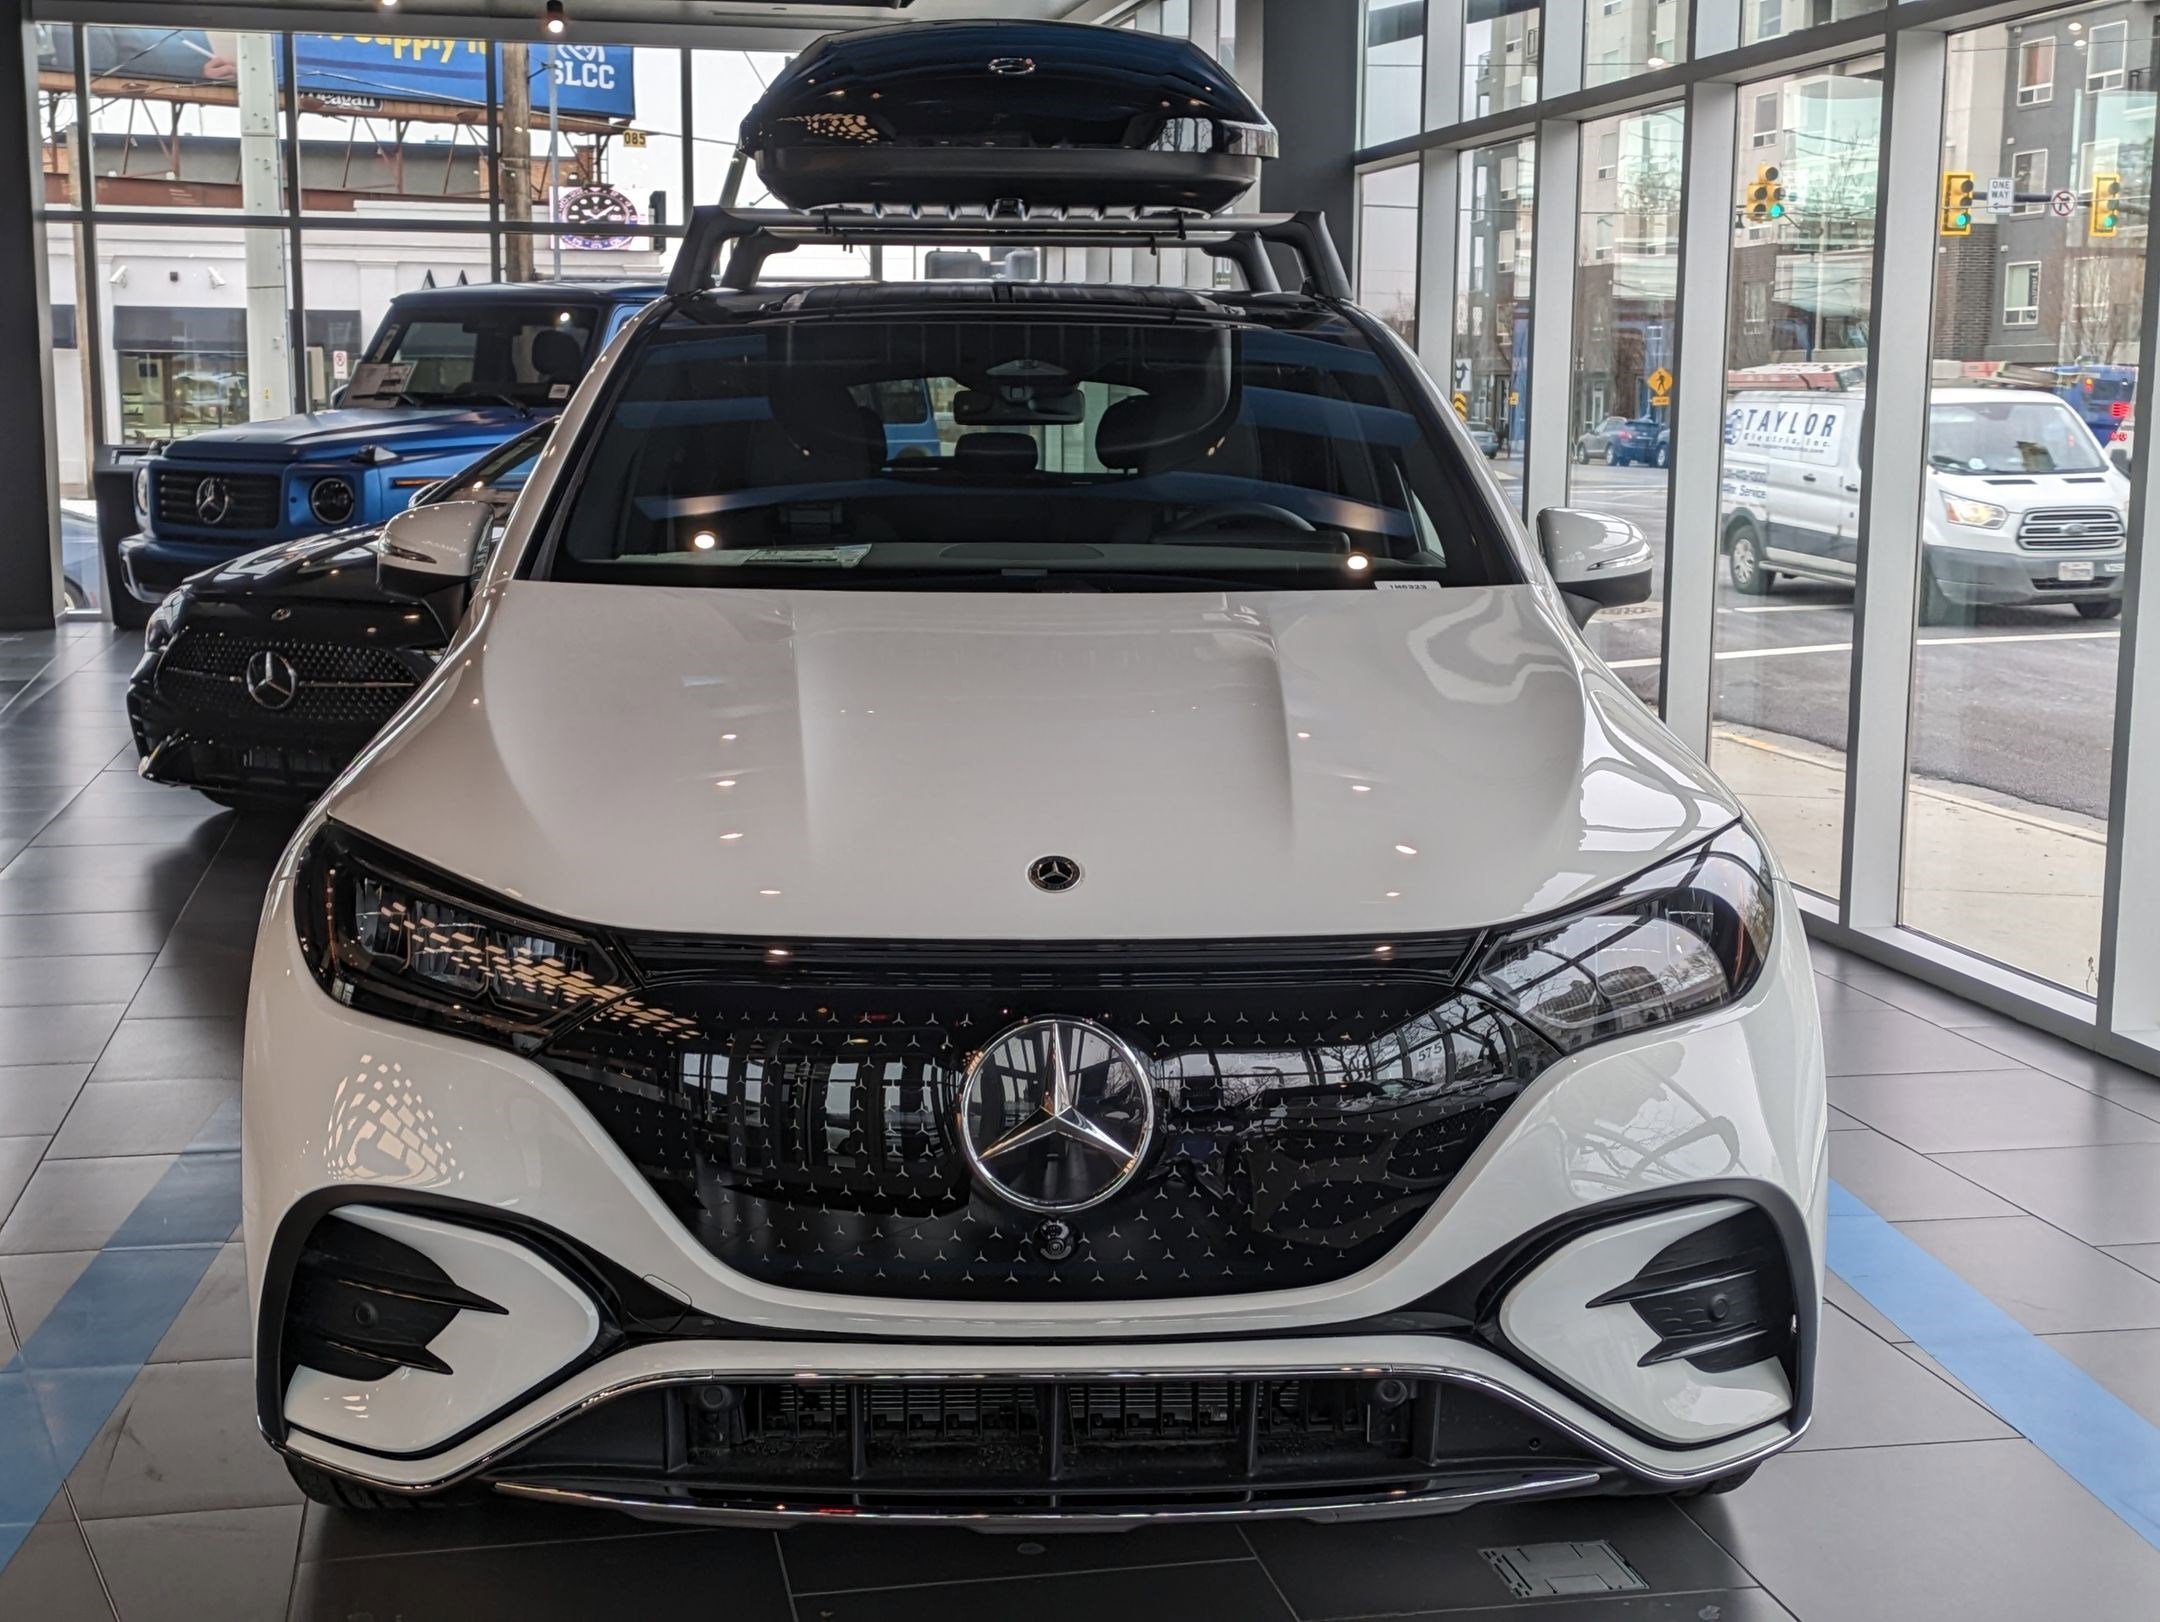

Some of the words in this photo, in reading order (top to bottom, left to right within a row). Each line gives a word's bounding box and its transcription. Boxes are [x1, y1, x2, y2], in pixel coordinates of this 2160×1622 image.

[554, 60, 615, 90] SLCC
[624, 132, 646, 146] 085
[1992, 181, 2010, 189] ONE
[1991, 191, 2009, 199] WAY
[1745, 409, 1836, 437] TAYLOR
[1418, 1042, 1443, 1062] 575
